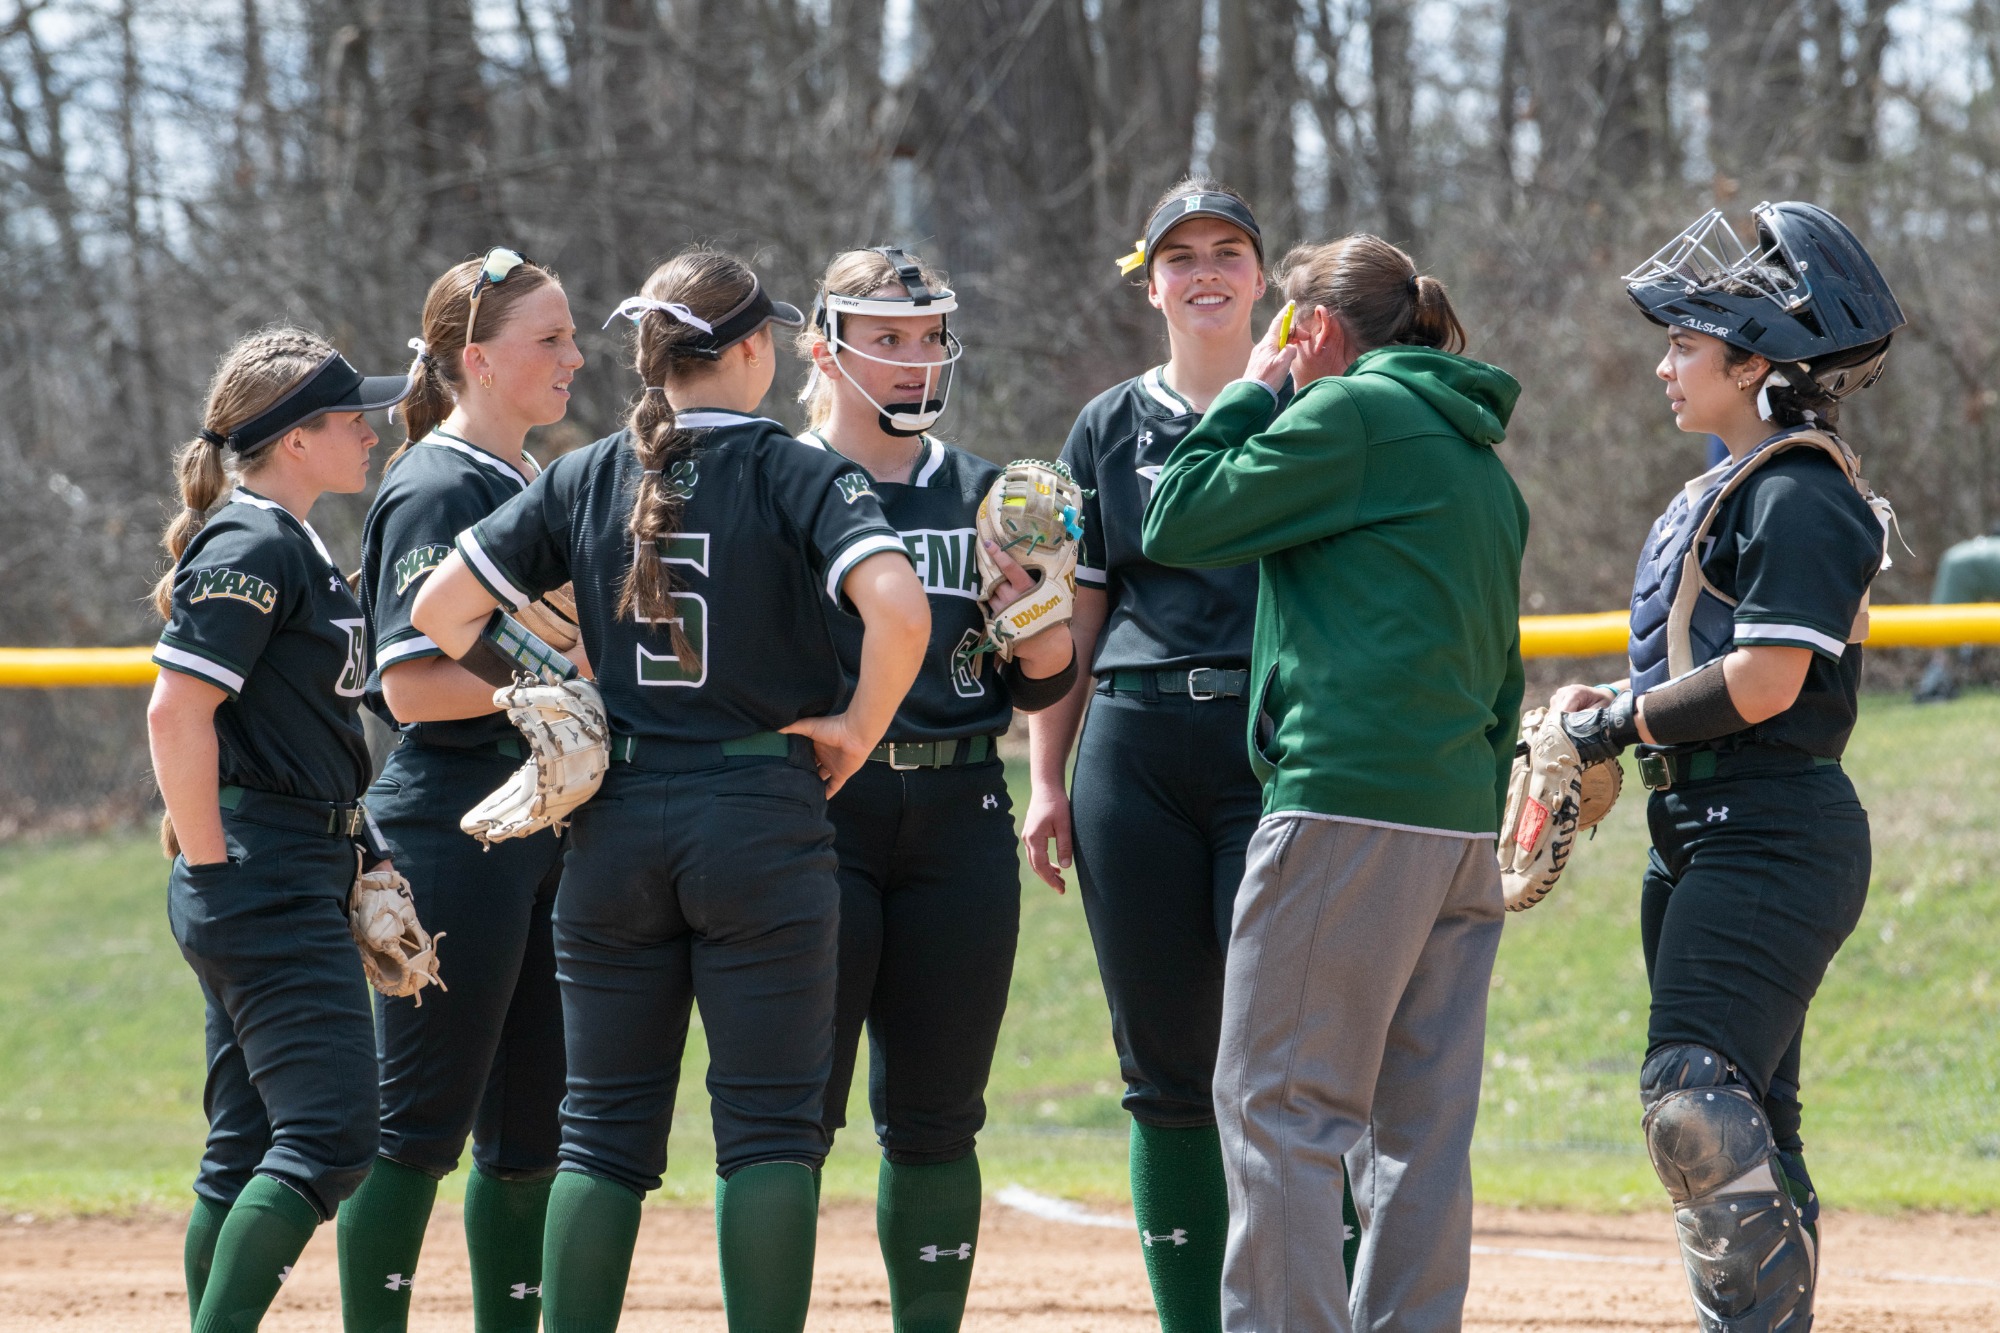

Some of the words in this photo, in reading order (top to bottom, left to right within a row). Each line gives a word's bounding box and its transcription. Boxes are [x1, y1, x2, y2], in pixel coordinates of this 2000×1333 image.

[1681, 318, 1730, 338] ALL-STAR
[834, 473, 874, 504] MA
[396, 545, 452, 595] MAA
[902, 533, 982, 595] ENA
[190, 568, 278, 614] MAAC
[635, 533, 710, 689] 5
[1010, 594, 1062, 628] Wilson
